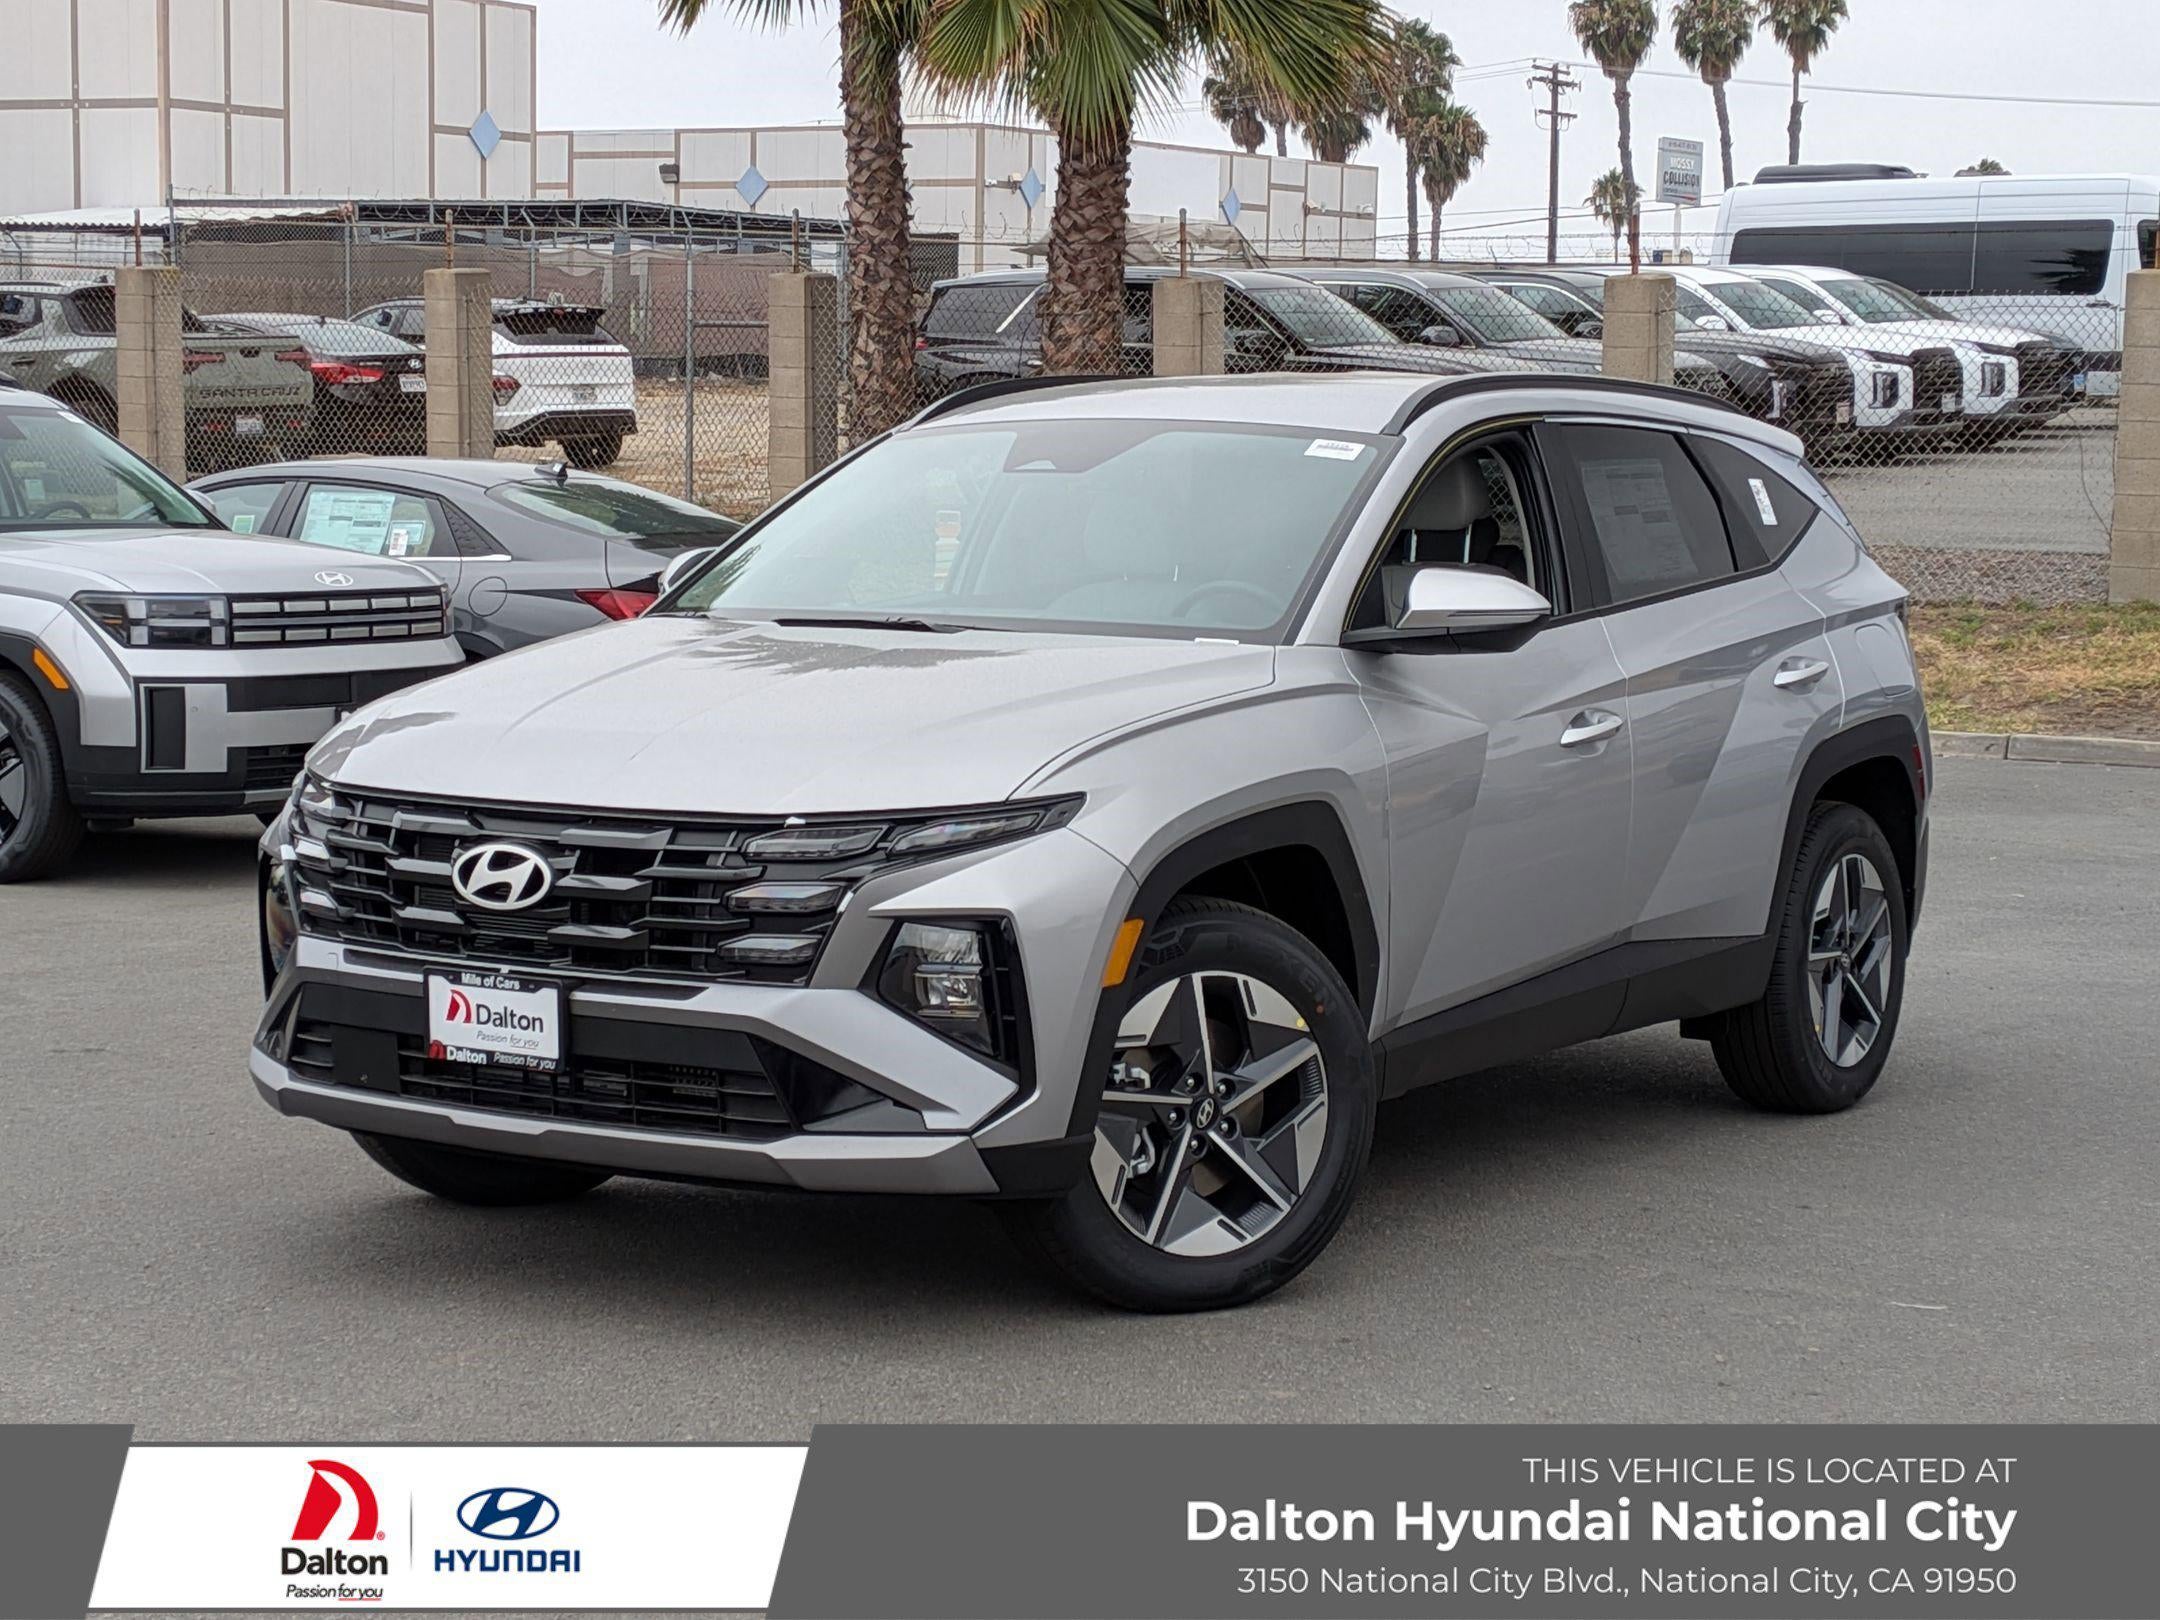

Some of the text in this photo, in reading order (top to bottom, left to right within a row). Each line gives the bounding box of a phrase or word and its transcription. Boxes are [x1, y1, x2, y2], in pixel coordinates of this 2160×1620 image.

[1663, 171, 1700, 187] COLLISION
[199, 386, 300, 399] SANTA CRUZ
[461, 972, 521, 990] Mile of Cars
[475, 1003, 544, 1033] Dalton
[476, 1031, 540, 1048] Passion for you
[446, 1046, 557, 1071] Dalton Passion for you
